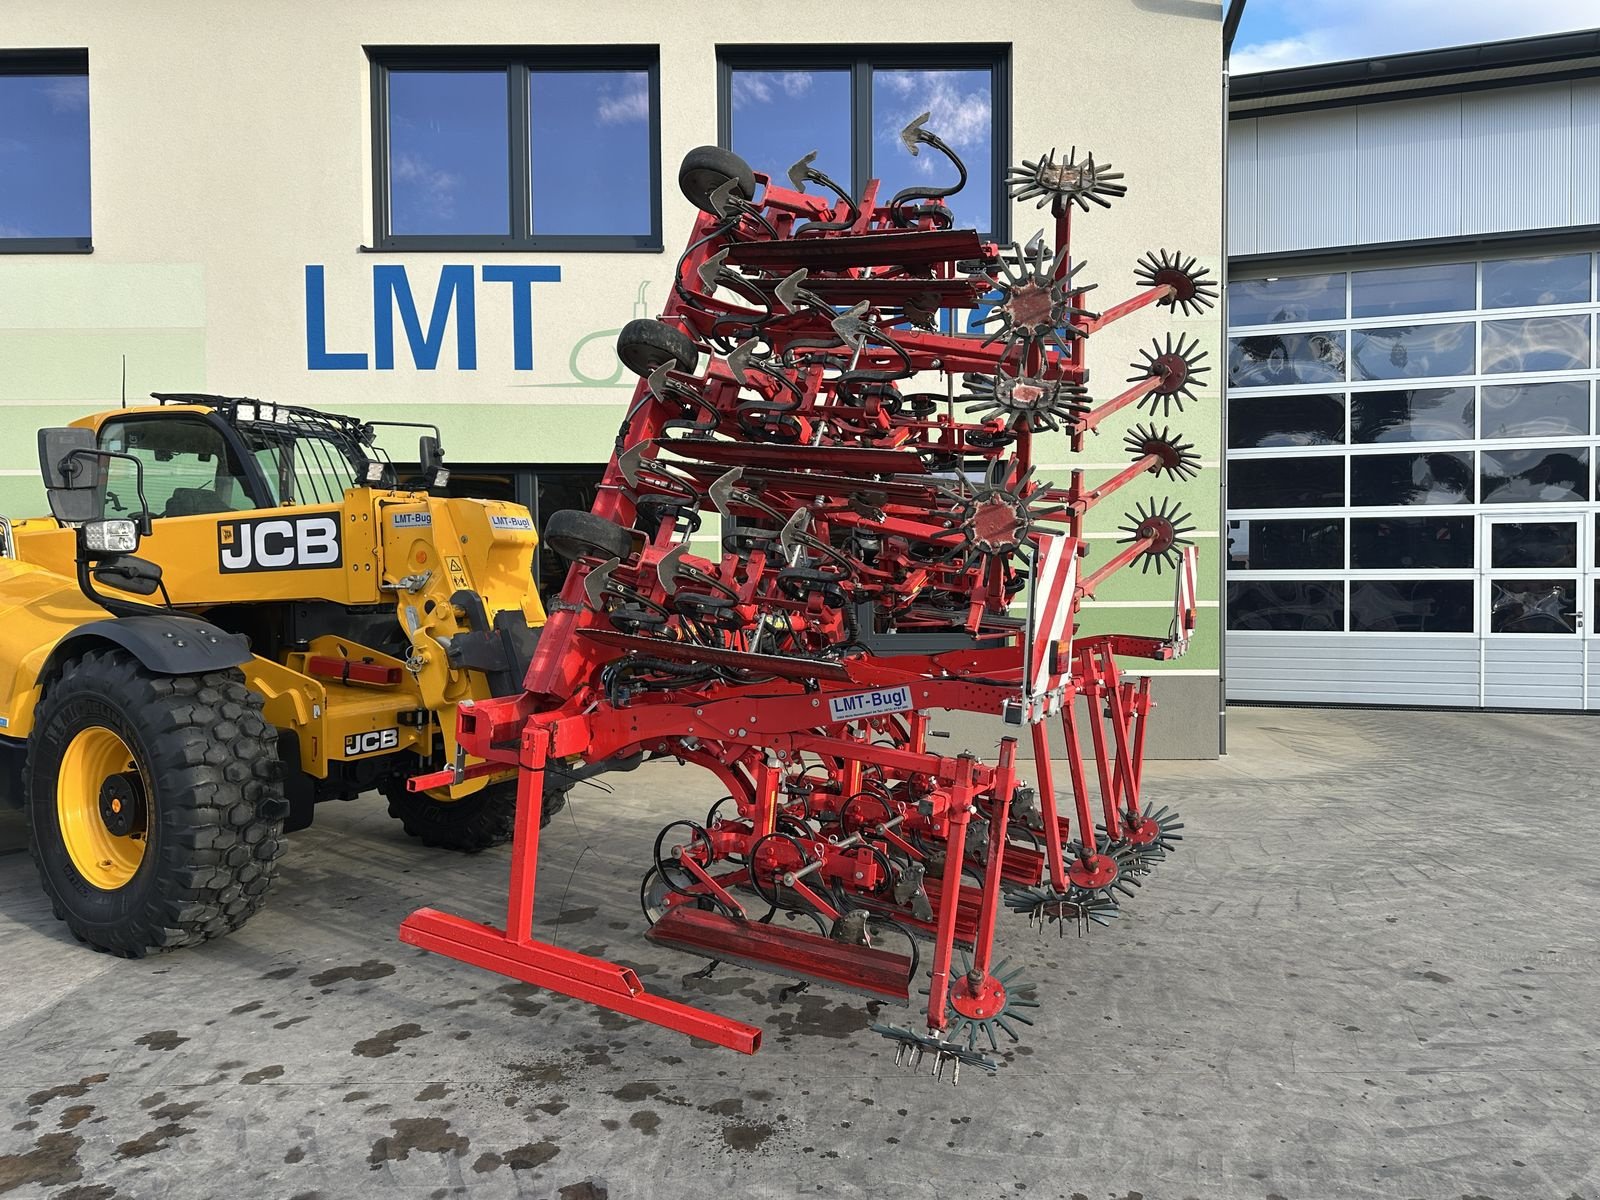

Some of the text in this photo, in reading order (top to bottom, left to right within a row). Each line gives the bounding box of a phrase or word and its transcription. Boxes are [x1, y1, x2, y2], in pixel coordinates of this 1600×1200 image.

[305, 264, 562, 370] LMT
[394, 513, 432, 524] LMT-Bug
[492, 516, 530, 528] LMT-Bugl
[221, 517, 339, 569] JCB
[834, 687, 907, 713] LMT-Bugl
[345, 729, 398, 755] JCB
